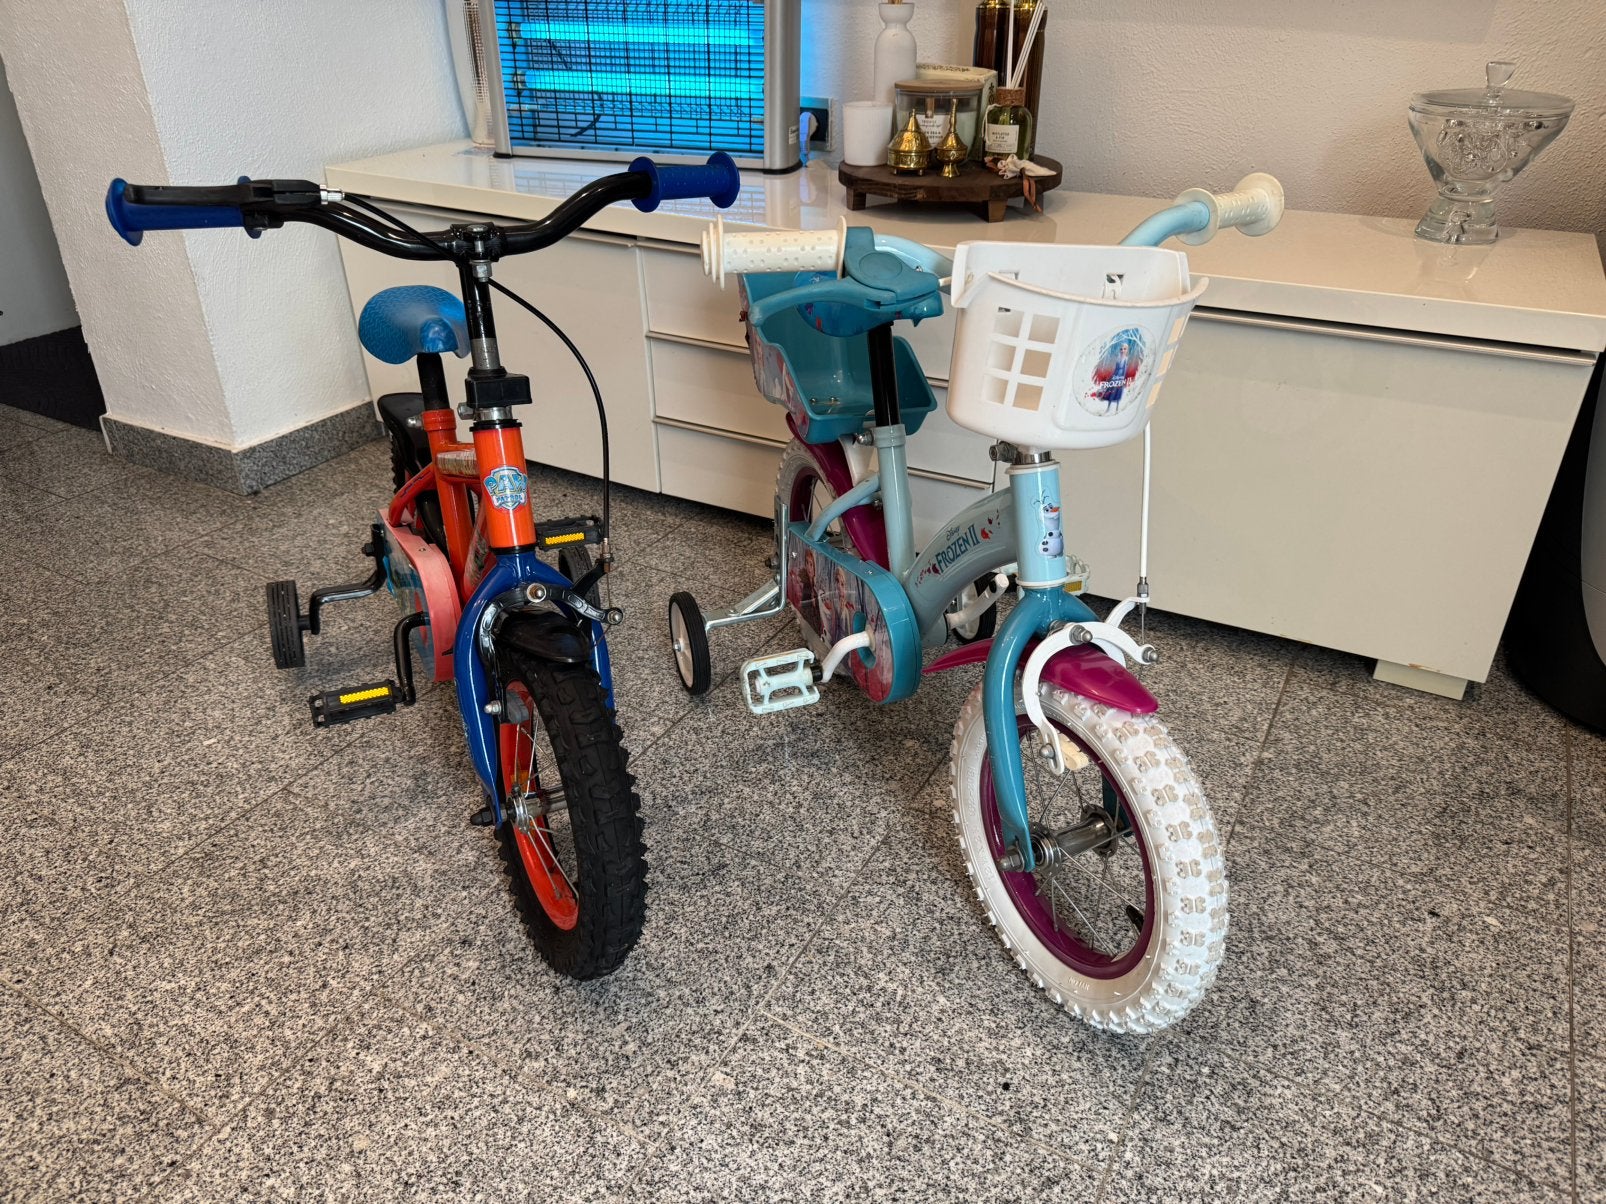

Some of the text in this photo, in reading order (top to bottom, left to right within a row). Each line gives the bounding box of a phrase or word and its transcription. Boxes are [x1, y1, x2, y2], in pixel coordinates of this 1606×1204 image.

[1101, 378, 1126, 389] FROZEN
[484, 471, 528, 495] PAW
[496, 494, 523, 504] PATROL
[935, 523, 981, 574] FROZEN II
